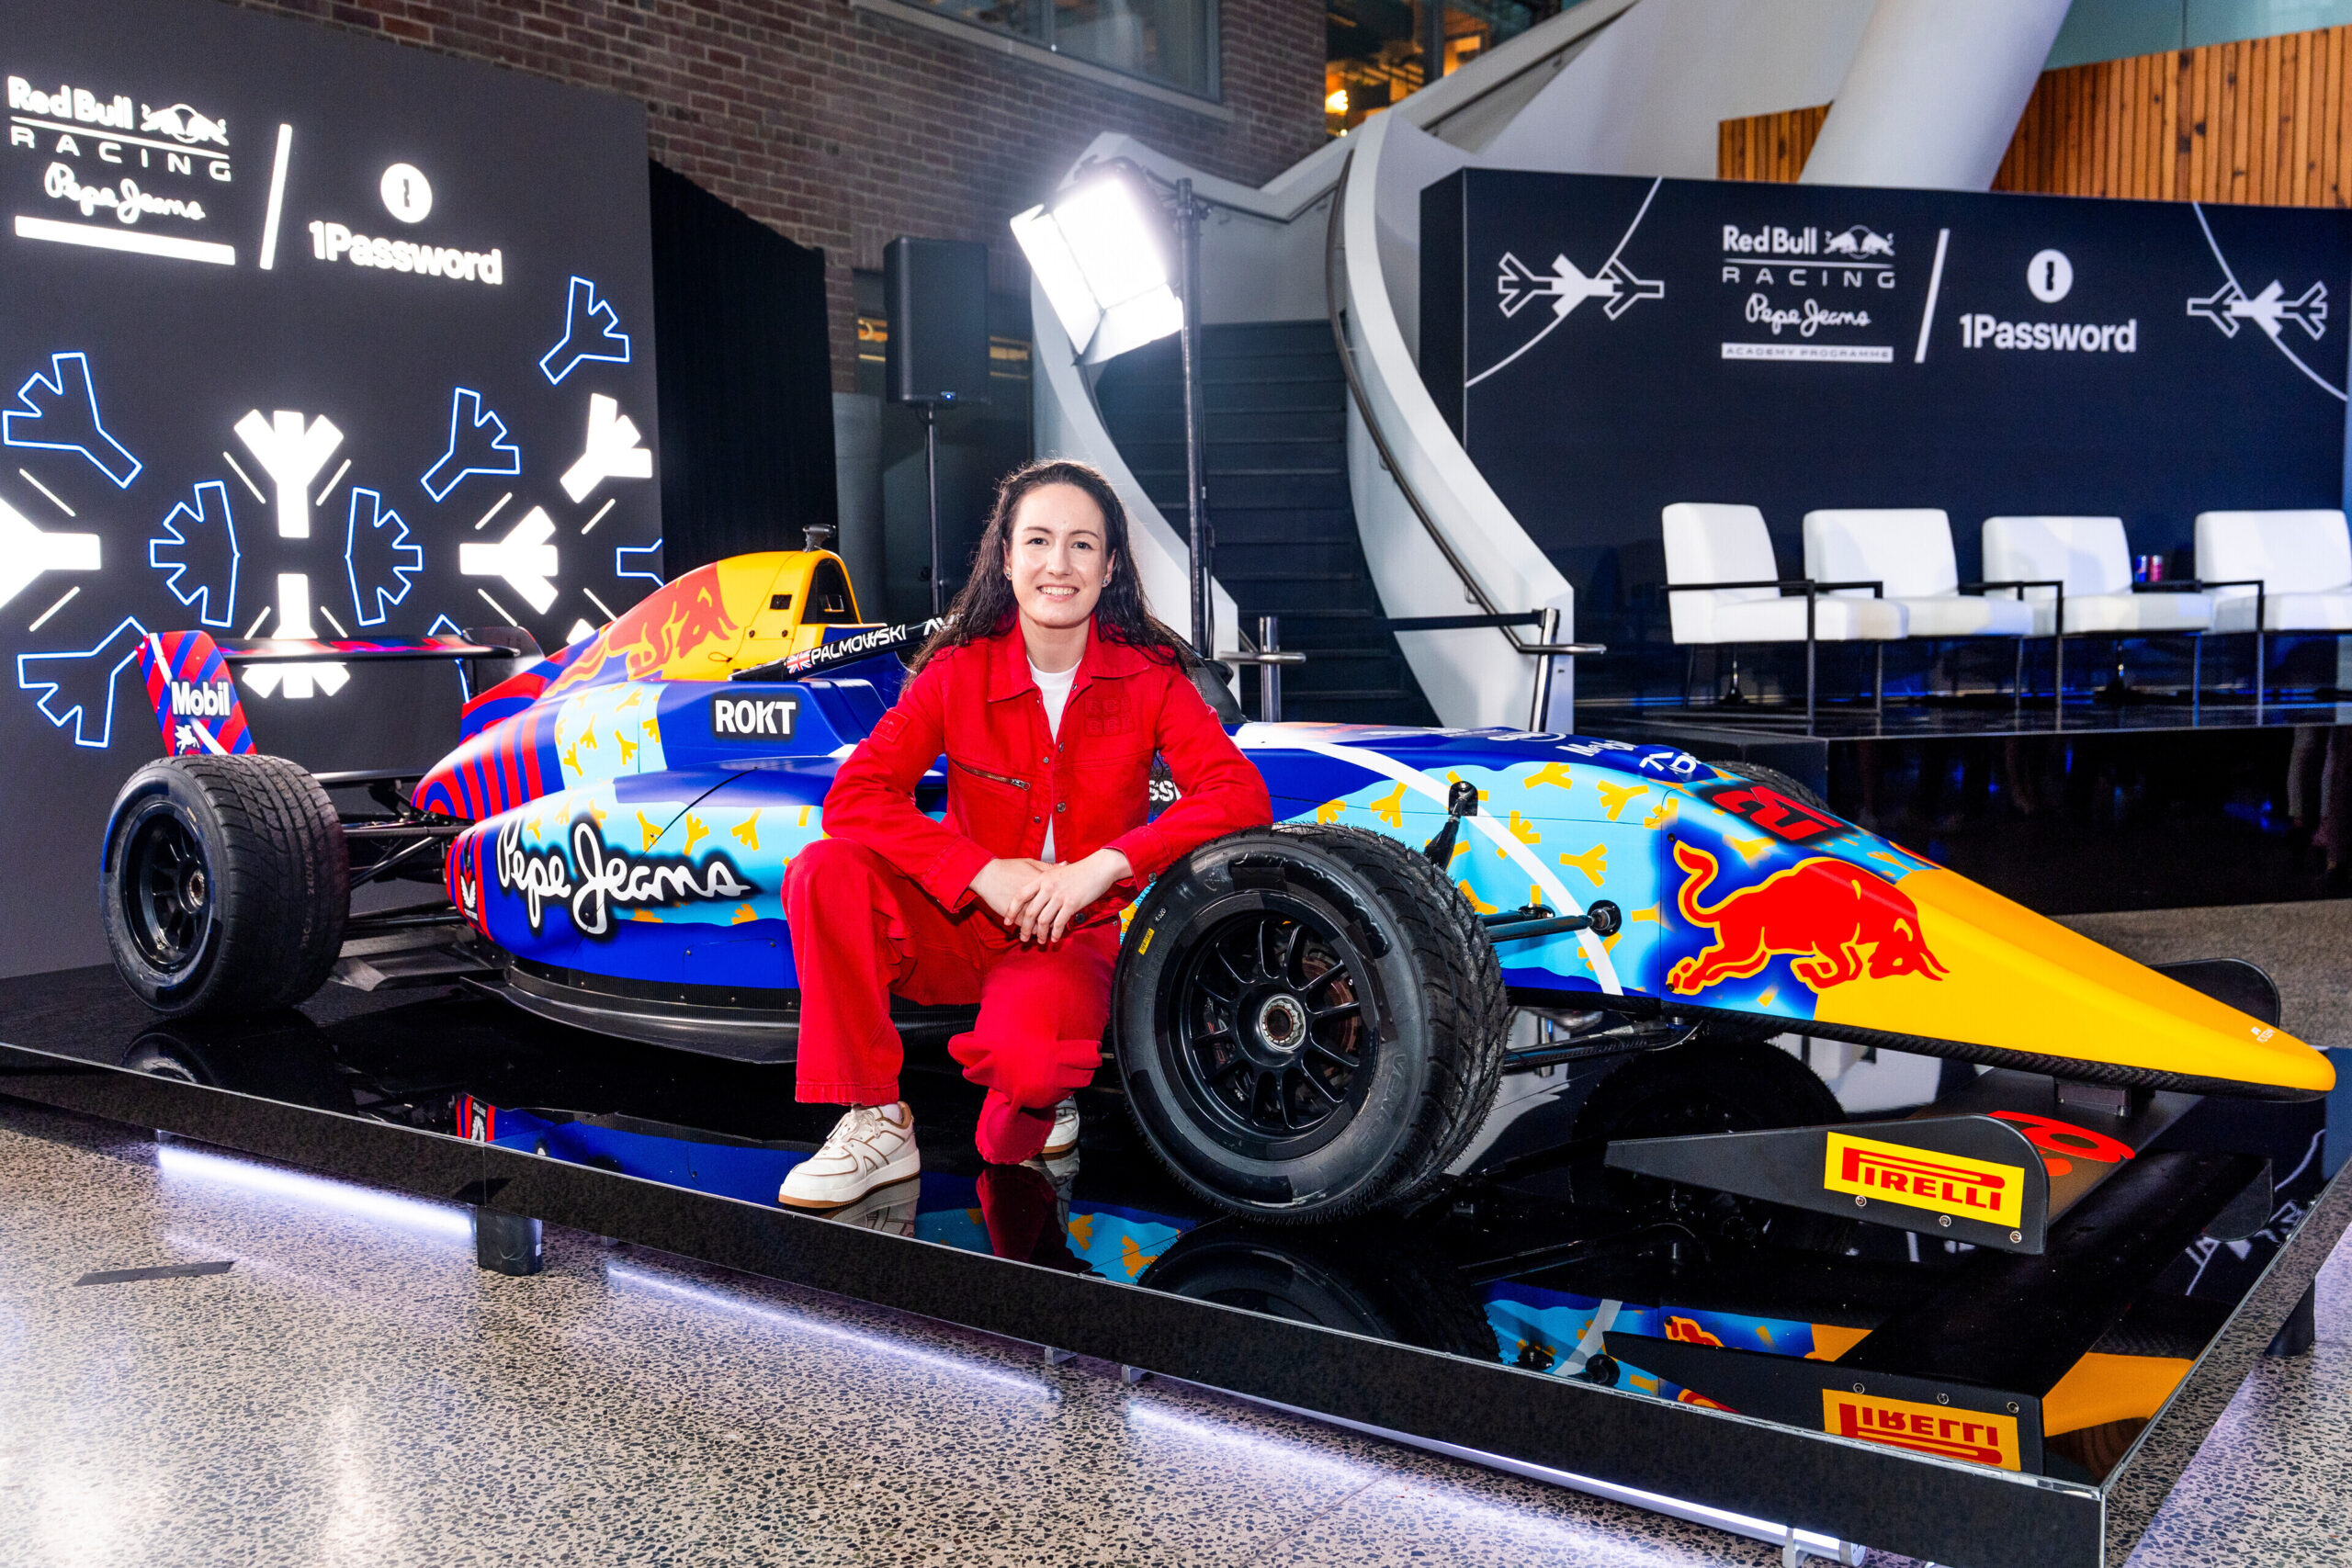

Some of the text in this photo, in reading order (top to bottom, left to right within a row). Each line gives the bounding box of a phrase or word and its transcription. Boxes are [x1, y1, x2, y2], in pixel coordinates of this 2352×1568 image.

[10, 125, 232, 182] RACING
[45, 162, 118, 216] Pepe
[310, 220, 503, 285] 1Password
[1723, 266, 1895, 288] RACING
[1746, 293, 1871, 337] Pepe Jeans
[1960, 313, 2137, 353] 1Password
[1725, 347, 1890, 359] ACADEMY PROGRAMME
[810, 624, 907, 665] PALMOWSKI
[171, 682, 231, 716] Mobil
[715, 699, 797, 735] ROKT
[496, 811, 752, 935] Pepe Jeans
[1841, 1146, 2006, 1212] PIRELLI
